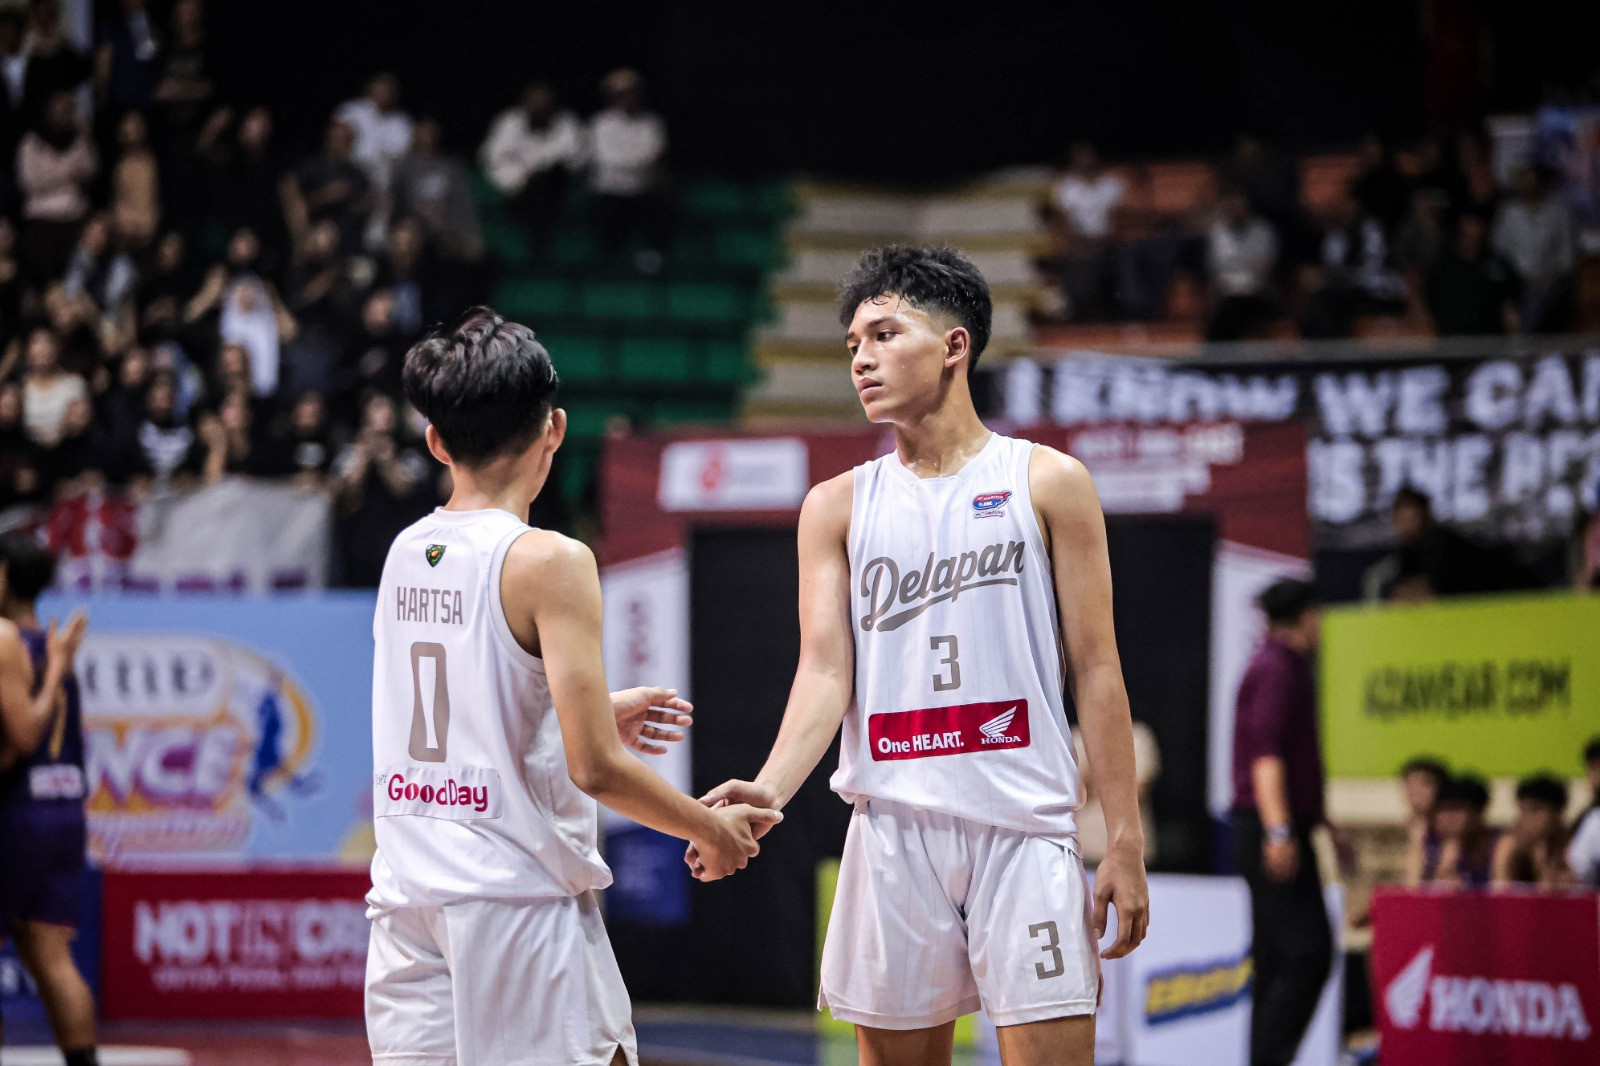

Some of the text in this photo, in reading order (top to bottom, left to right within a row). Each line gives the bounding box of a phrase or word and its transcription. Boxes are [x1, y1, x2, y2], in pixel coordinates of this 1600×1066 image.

[1314, 366, 1450, 436] WE
[397, 586, 463, 625] HARTSA
[861, 541, 1026, 632] Delapan
[930, 635, 961, 691] 3
[408, 641, 450, 763] 0
[878, 730, 965, 754] One HEART.
[981, 735, 1022, 745] HONDA
[1028, 921, 1065, 980] 3
[1429, 975, 1591, 1040] HONDA
